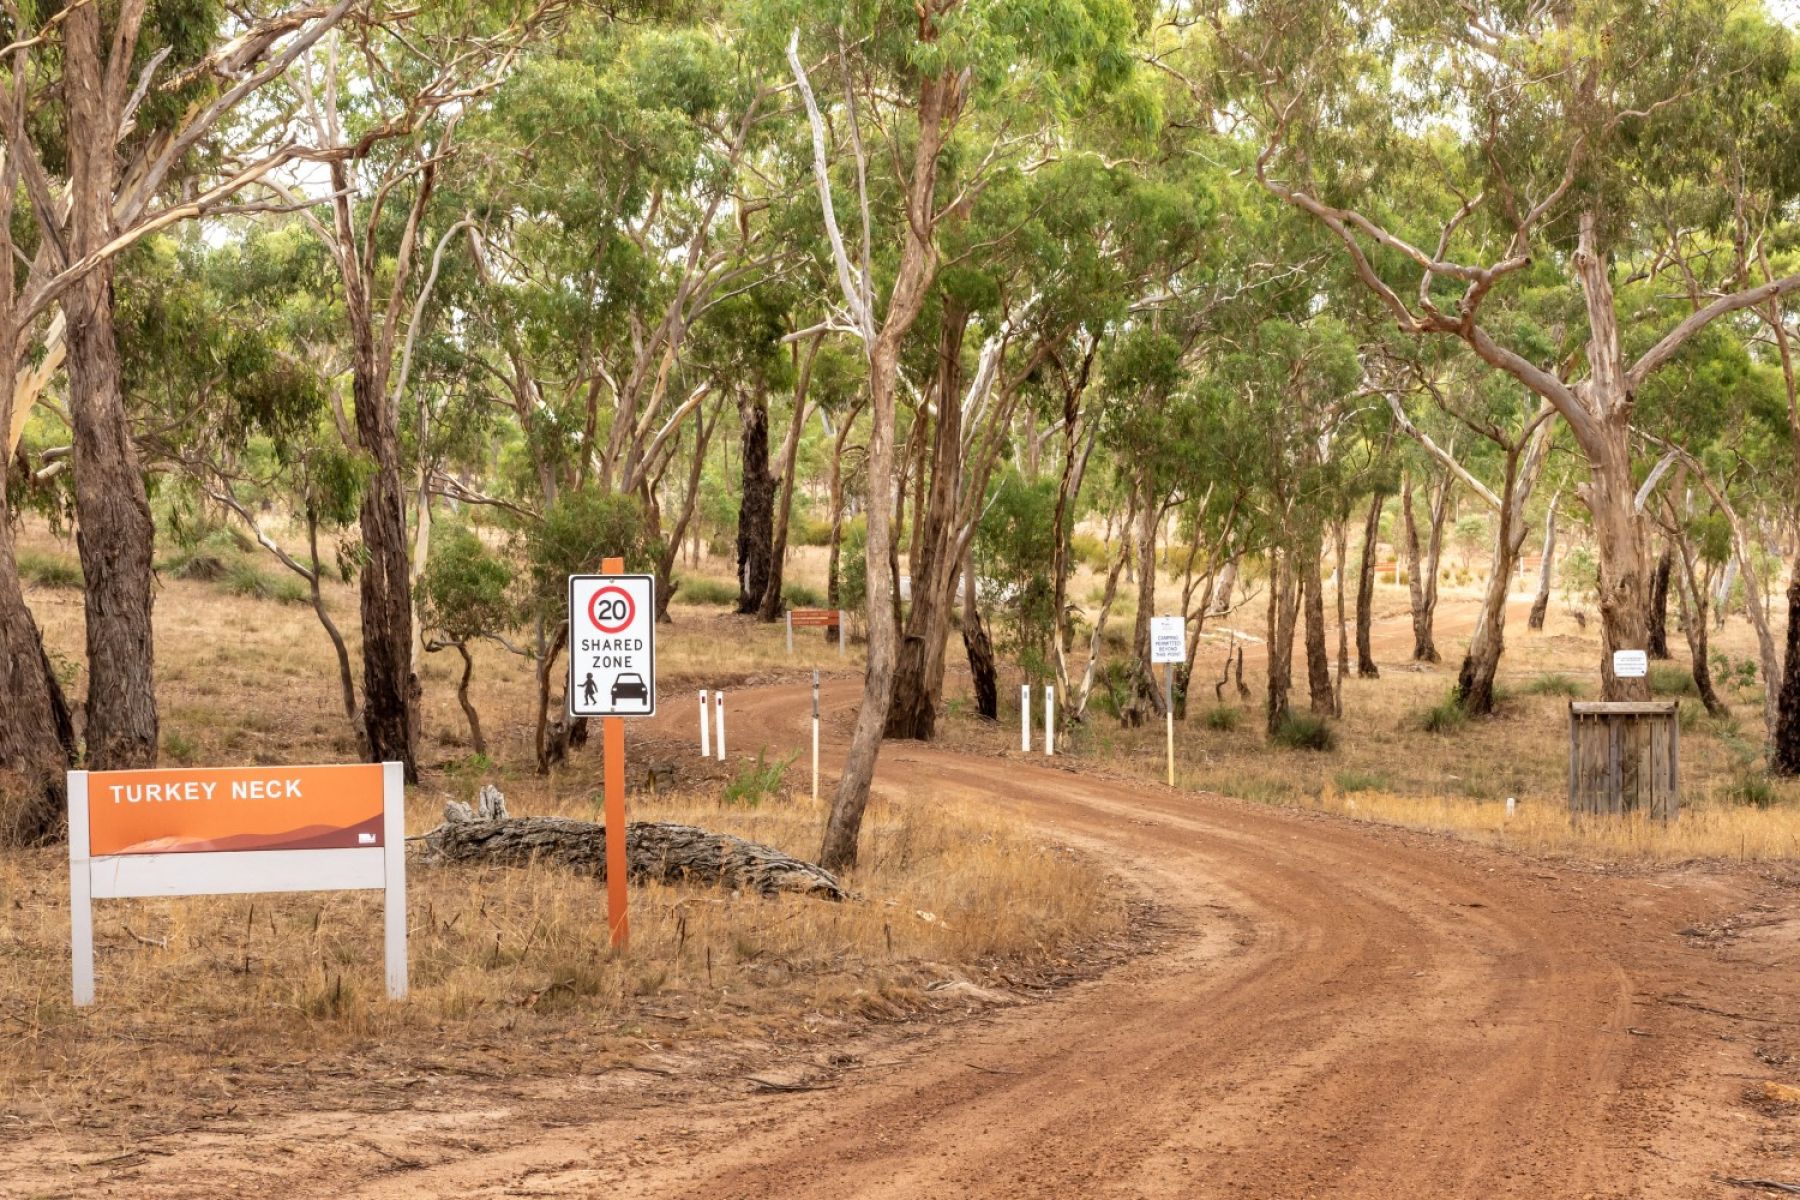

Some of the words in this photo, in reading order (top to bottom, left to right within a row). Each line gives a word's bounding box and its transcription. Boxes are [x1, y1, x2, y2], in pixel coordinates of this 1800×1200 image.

[598, 600, 627, 620] 20
[581, 639, 643, 651] SHARED
[592, 656, 633, 668] ZONE
[109, 782, 217, 804] TURKEY
[231, 779, 303, 799] NECK
